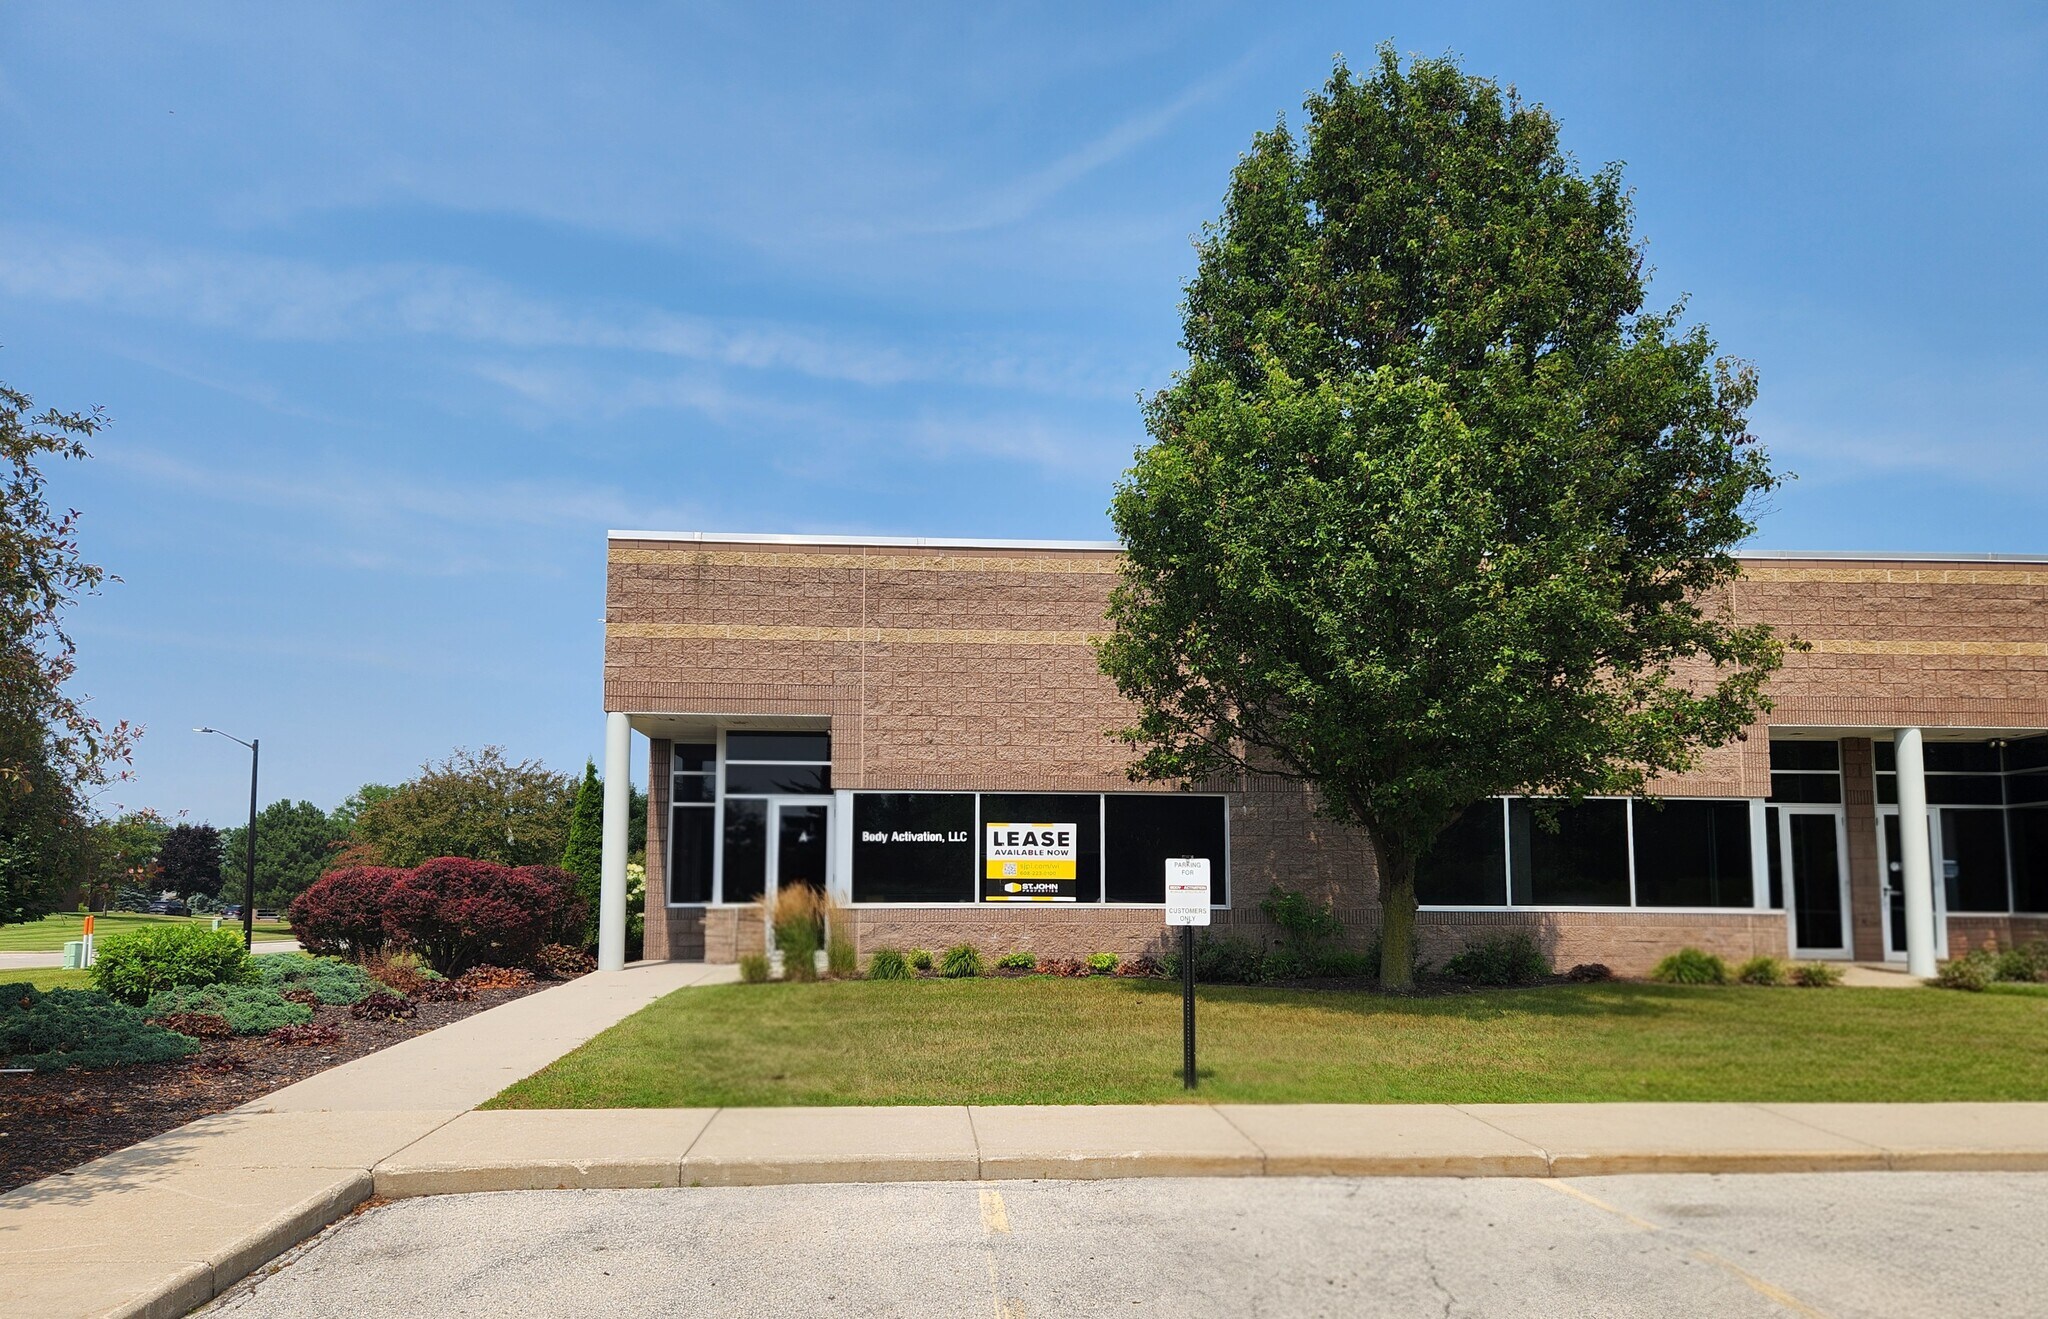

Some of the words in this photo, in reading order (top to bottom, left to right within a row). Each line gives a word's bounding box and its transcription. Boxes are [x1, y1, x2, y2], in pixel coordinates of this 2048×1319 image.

[862, 831, 888, 844] Body
[891, 831, 945, 843] Activation,
[948, 831, 968, 842] LLC
[993, 831, 1070, 847] LEASE
